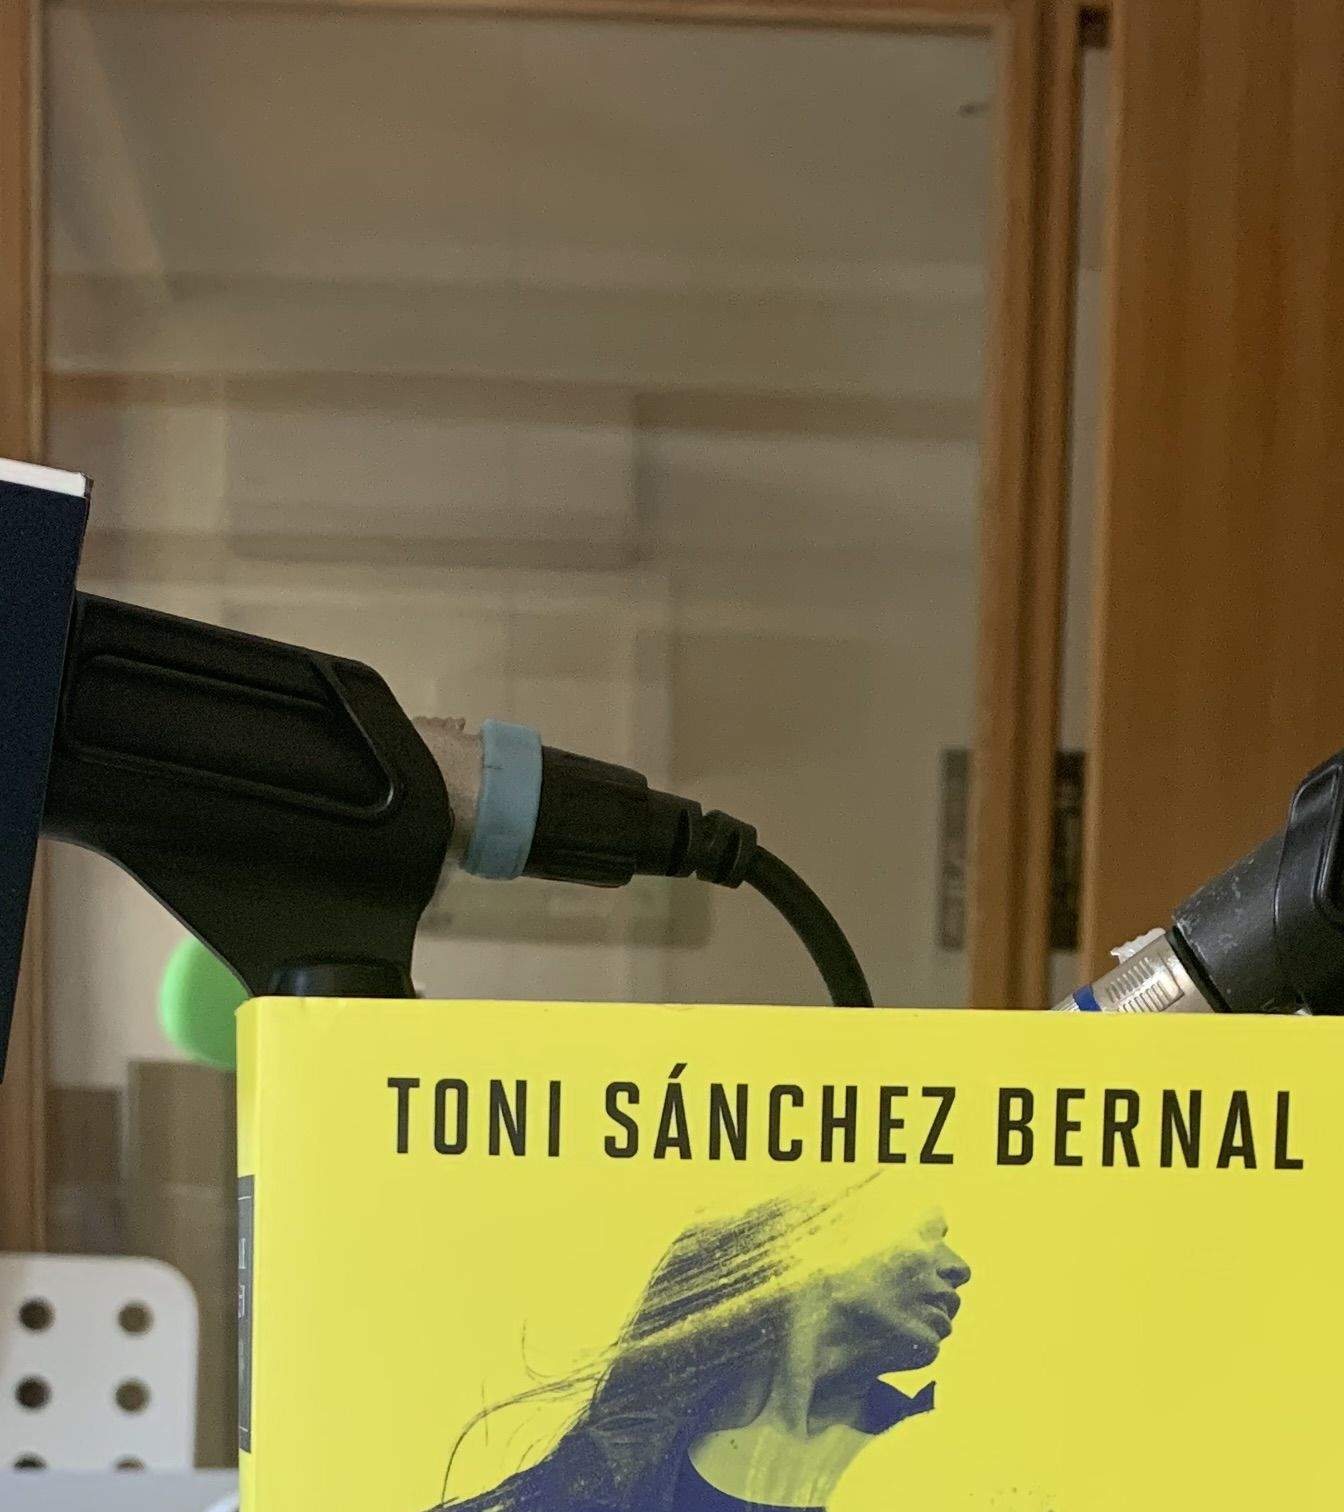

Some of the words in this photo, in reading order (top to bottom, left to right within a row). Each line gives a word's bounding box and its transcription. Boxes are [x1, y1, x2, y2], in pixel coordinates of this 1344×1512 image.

[387, 1077, 562, 1158] TONI
[604, 1063, 956, 1165] SÁNCHEZ
[996, 1087, 1305, 1170] BERNAL
